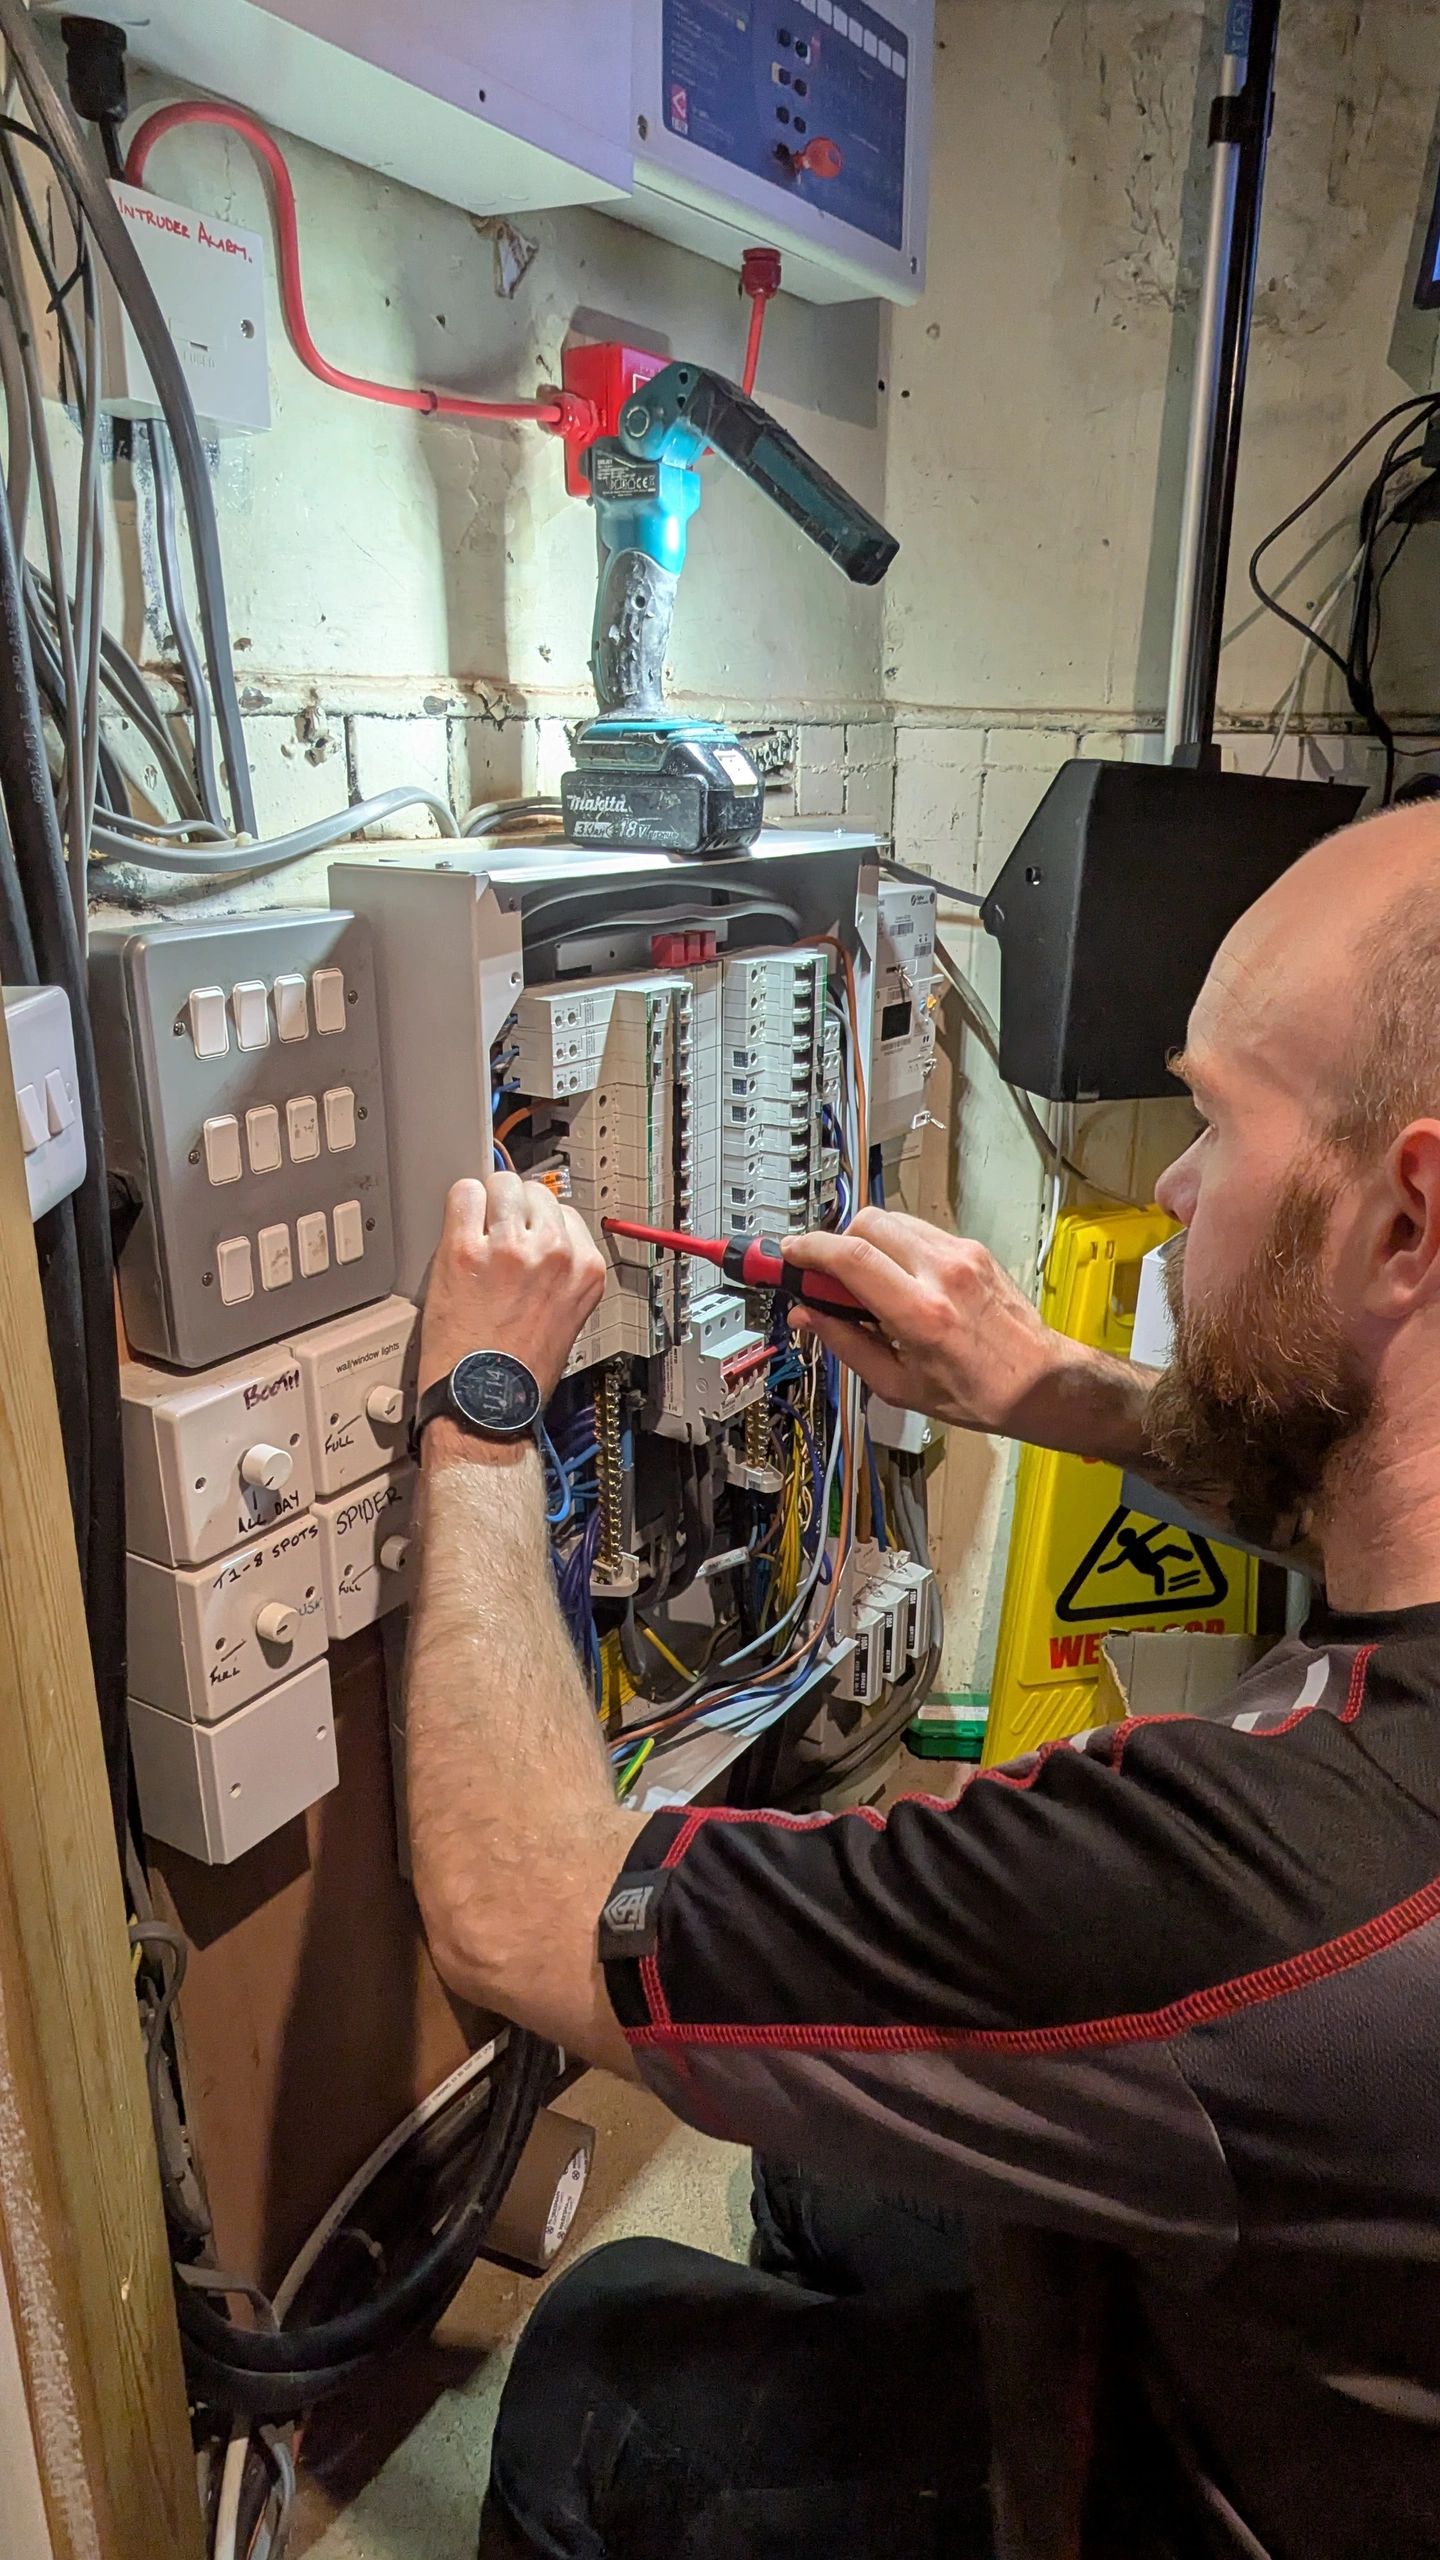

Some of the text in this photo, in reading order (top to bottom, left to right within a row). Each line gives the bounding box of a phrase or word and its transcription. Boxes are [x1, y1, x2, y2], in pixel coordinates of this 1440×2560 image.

[118, 197, 190, 239] INTRUDER
[381, 1342, 400, 1356] lights
[325, 1434, 354, 1455] FULL
[239, 1490, 300, 1533] ALL DAY
[336, 1486, 403, 1535] SPIDER
[271, 1525, 319, 1558] SPOTS
[338, 1580, 361, 1595] FULL
[1049, 1631, 1108, 1670] WE
